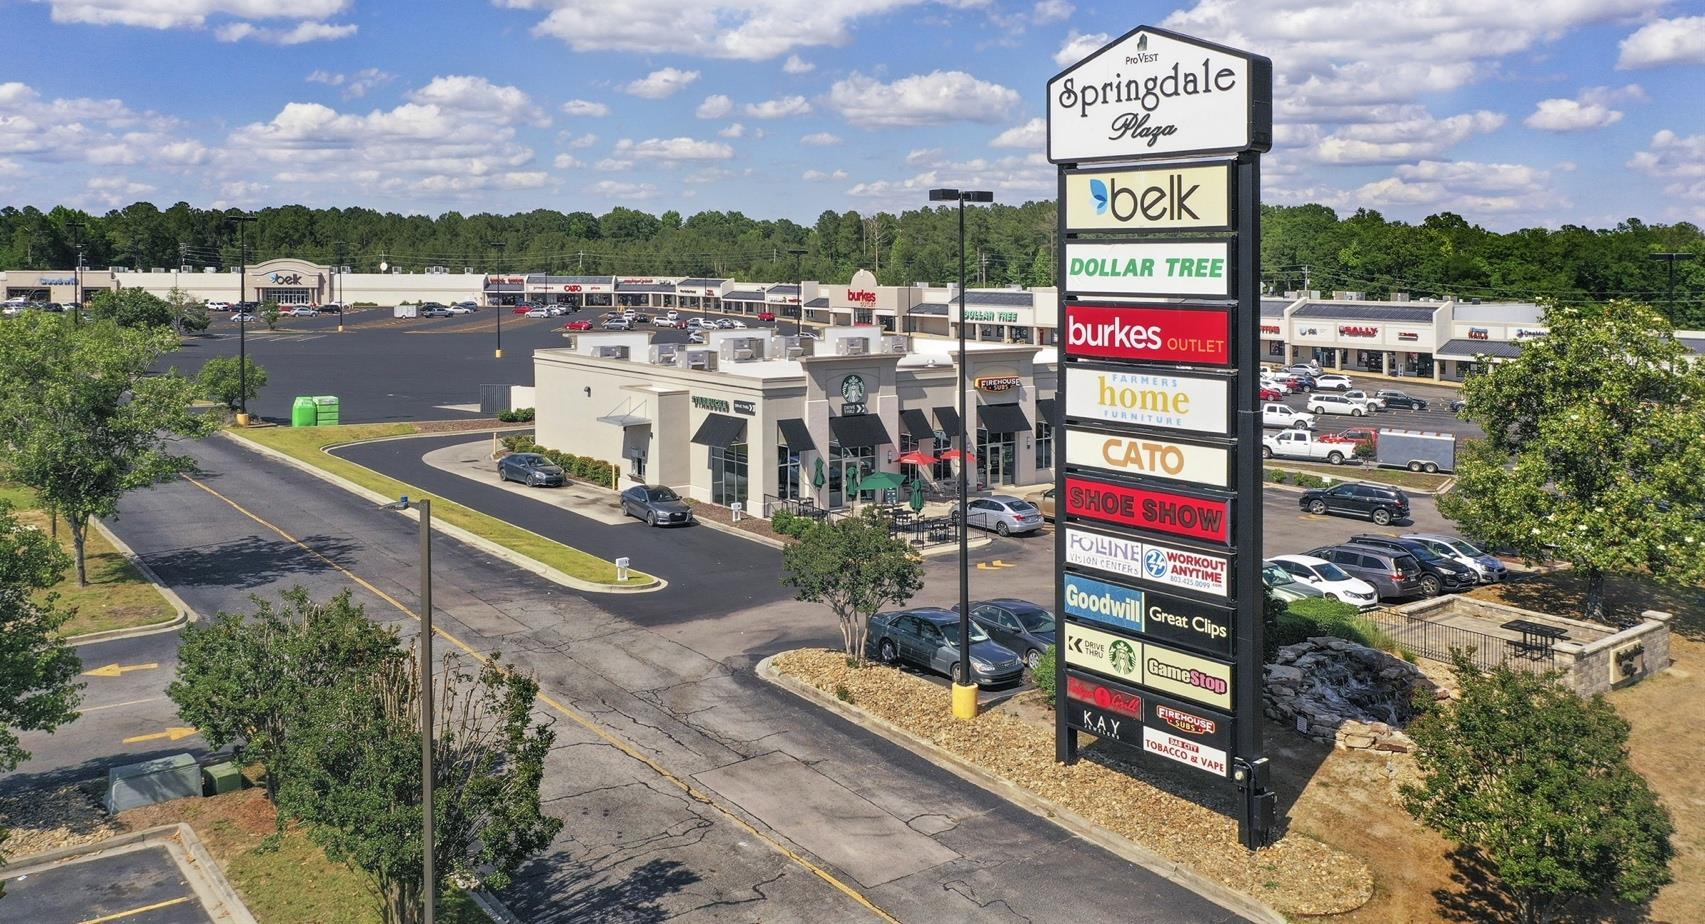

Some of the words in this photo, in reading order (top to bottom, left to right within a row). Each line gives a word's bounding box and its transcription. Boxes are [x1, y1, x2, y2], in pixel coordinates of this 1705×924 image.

[1058, 58, 1236, 117] Springdale
[1108, 112, 1178, 147] Plaza
[1110, 174, 1201, 222] belk
[275, 273, 303, 286] belk
[1069, 258, 1155, 277] DOLLAR
[1165, 258, 1225, 278] TREE
[564, 284, 582, 293] CATO
[847, 288, 876, 302] burkes
[998, 311, 1018, 322] TREE
[1068, 315, 1162, 350] burkes
[1166, 337, 1225, 353] OUTLET
[1344, 326, 1378, 335] SALLY
[981, 378, 1020, 388] FIREHOUSE
[1112, 373, 1179, 388] FARMERS
[1097, 375, 1190, 415] home
[1104, 410, 1183, 426] FURNITURE
[1102, 438, 1185, 475] CATO
[1070, 486, 1135, 518] SHOE
[1142, 499, 1223, 533] SHOW
[1070, 533, 1139, 562] FOLLINE
[1070, 553, 1098, 566] VISION
[1101, 559, 1139, 576] CENTERS
[1166, 551, 1226, 571] WORKOUT
[1170, 564, 1222, 583] ANYTIME
[1065, 584, 1141, 623] Goodwill
[1149, 606, 1188, 628] Great
[1192, 616, 1227, 639] Clips
[1084, 640, 1105, 652] DRIVE
[1084, 648, 1104, 659] THRU
[1147, 658, 1228, 694] GameStop
[1083, 709, 1120, 734] KAY
[1158, 707, 1214, 732] FIREHOUSE
[1175, 720, 1196, 732] SUBS
[1145, 739, 1188, 760] TOBACCO
[1201, 757, 1224, 772] VAPE
